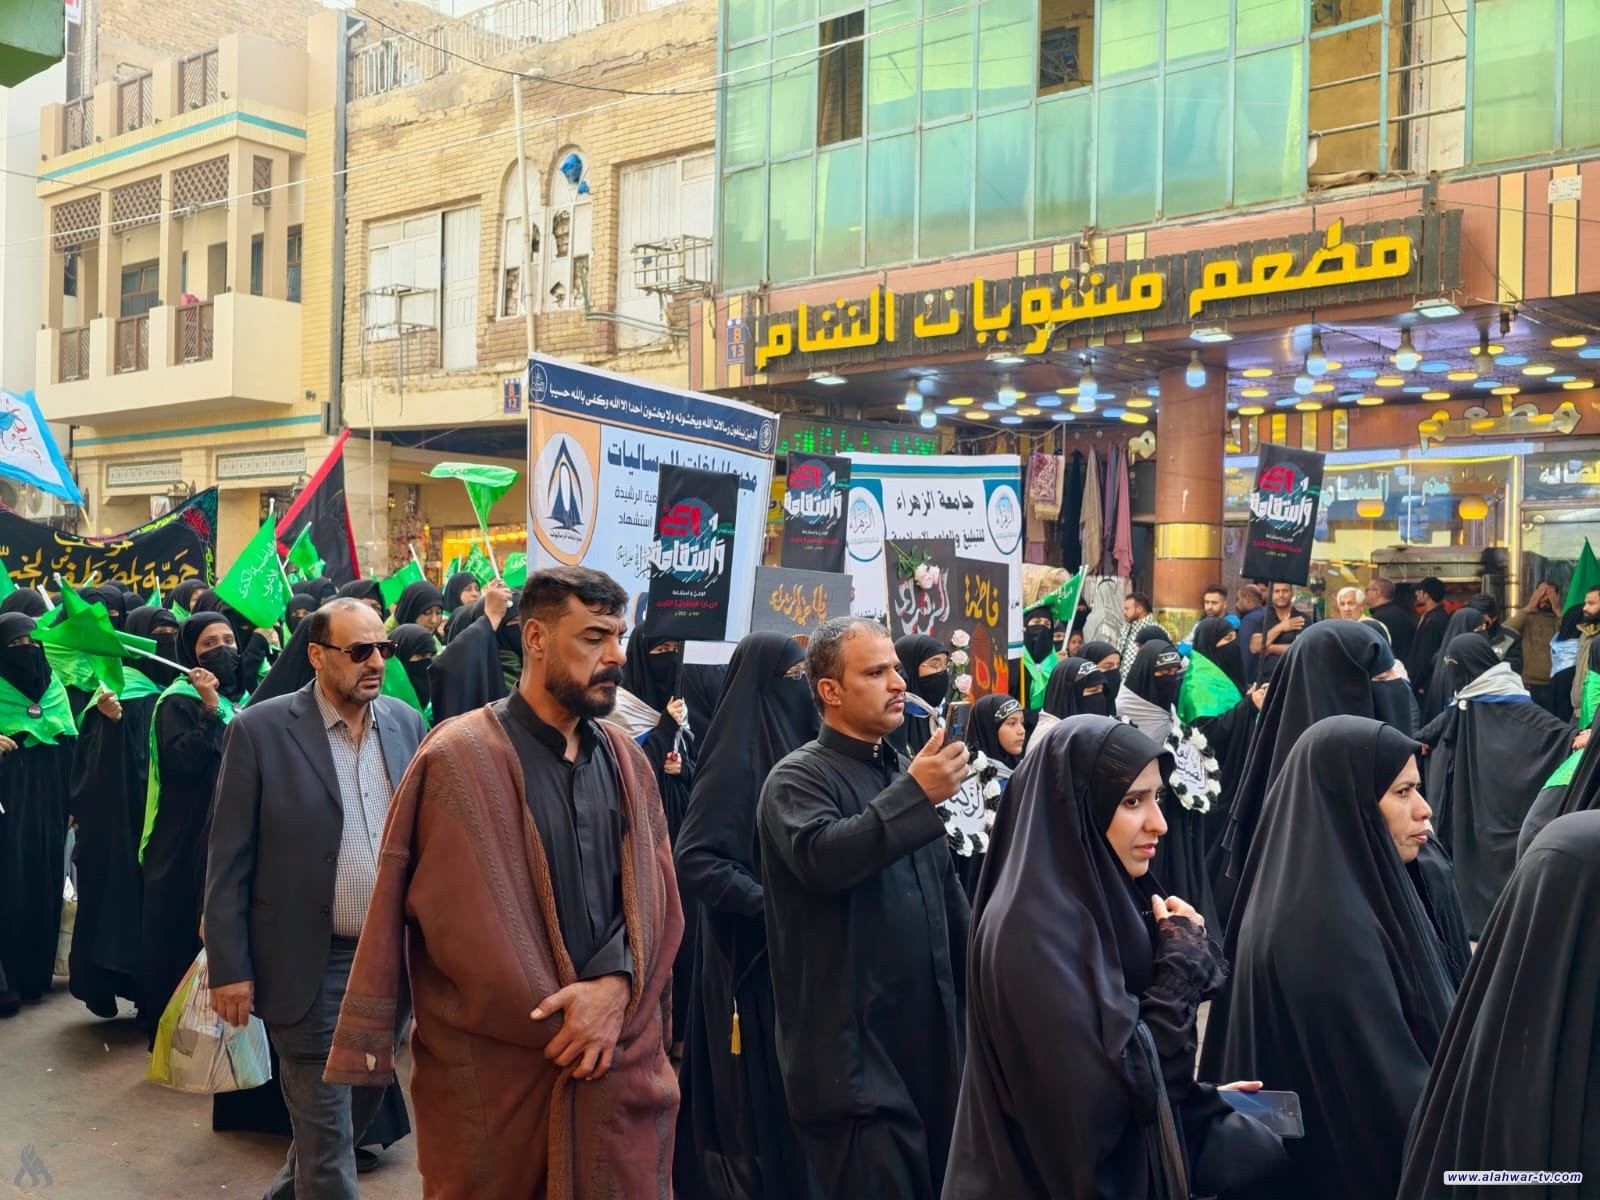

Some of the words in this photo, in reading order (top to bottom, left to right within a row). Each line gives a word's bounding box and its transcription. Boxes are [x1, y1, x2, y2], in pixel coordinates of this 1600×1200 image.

[1189, 217, 1411, 318] مطعم
[914, 262, 1163, 355] مشويات
[755, 286, 895, 371] الشام
[549, 382, 570, 399] حسيبا
[571, 386, 585, 405] بالله
[609, 395, 620, 409] الله
[614, 484, 643, 505] الرشيدة
[896, 489, 936, 517] الزهراء
[938, 489, 974, 516] جامعة
[618, 512, 652, 528] استشهاد
[962, 528, 985, 550] للتبليغ
[964, 573, 999, 628] فاطمة
